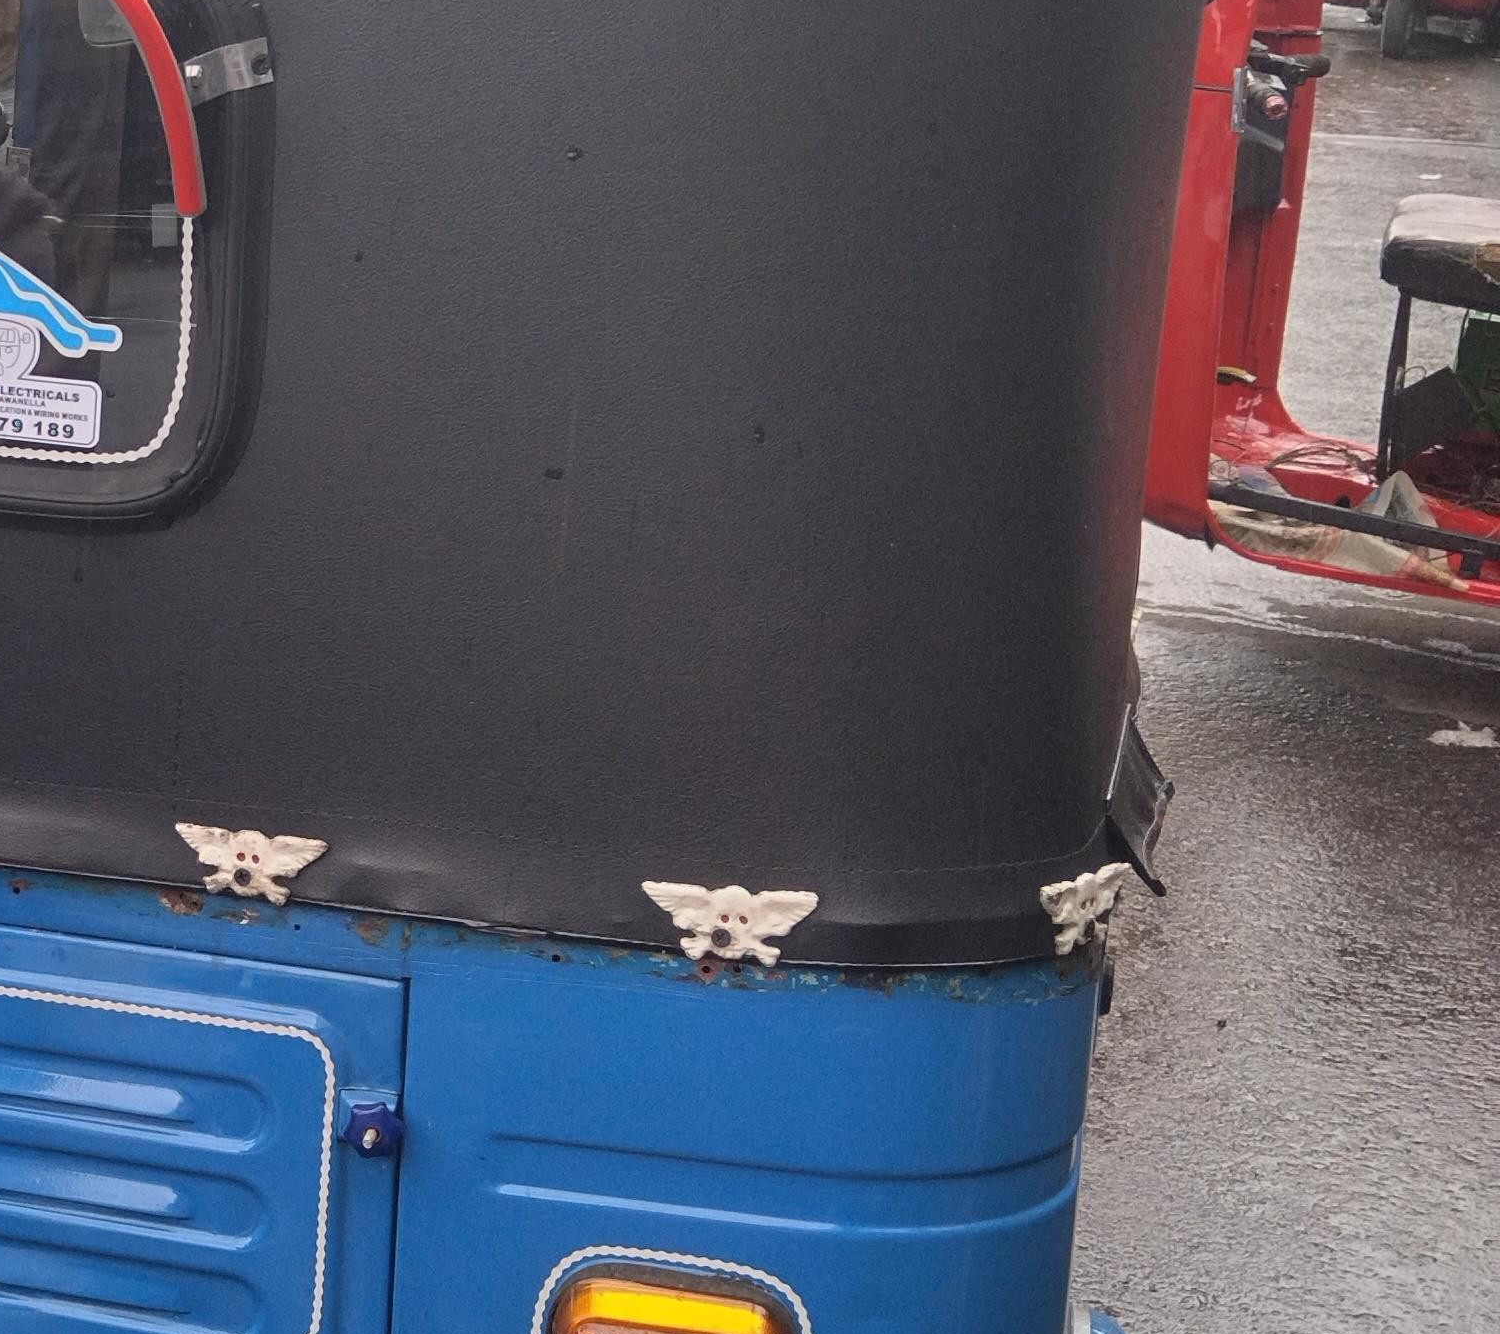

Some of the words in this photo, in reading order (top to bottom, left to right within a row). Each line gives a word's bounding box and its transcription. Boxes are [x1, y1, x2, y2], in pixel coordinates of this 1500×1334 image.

[34, 410, 60, 419] WIRING
[61, 413, 89, 422] WORKS
[34, 421, 74, 439] 189
